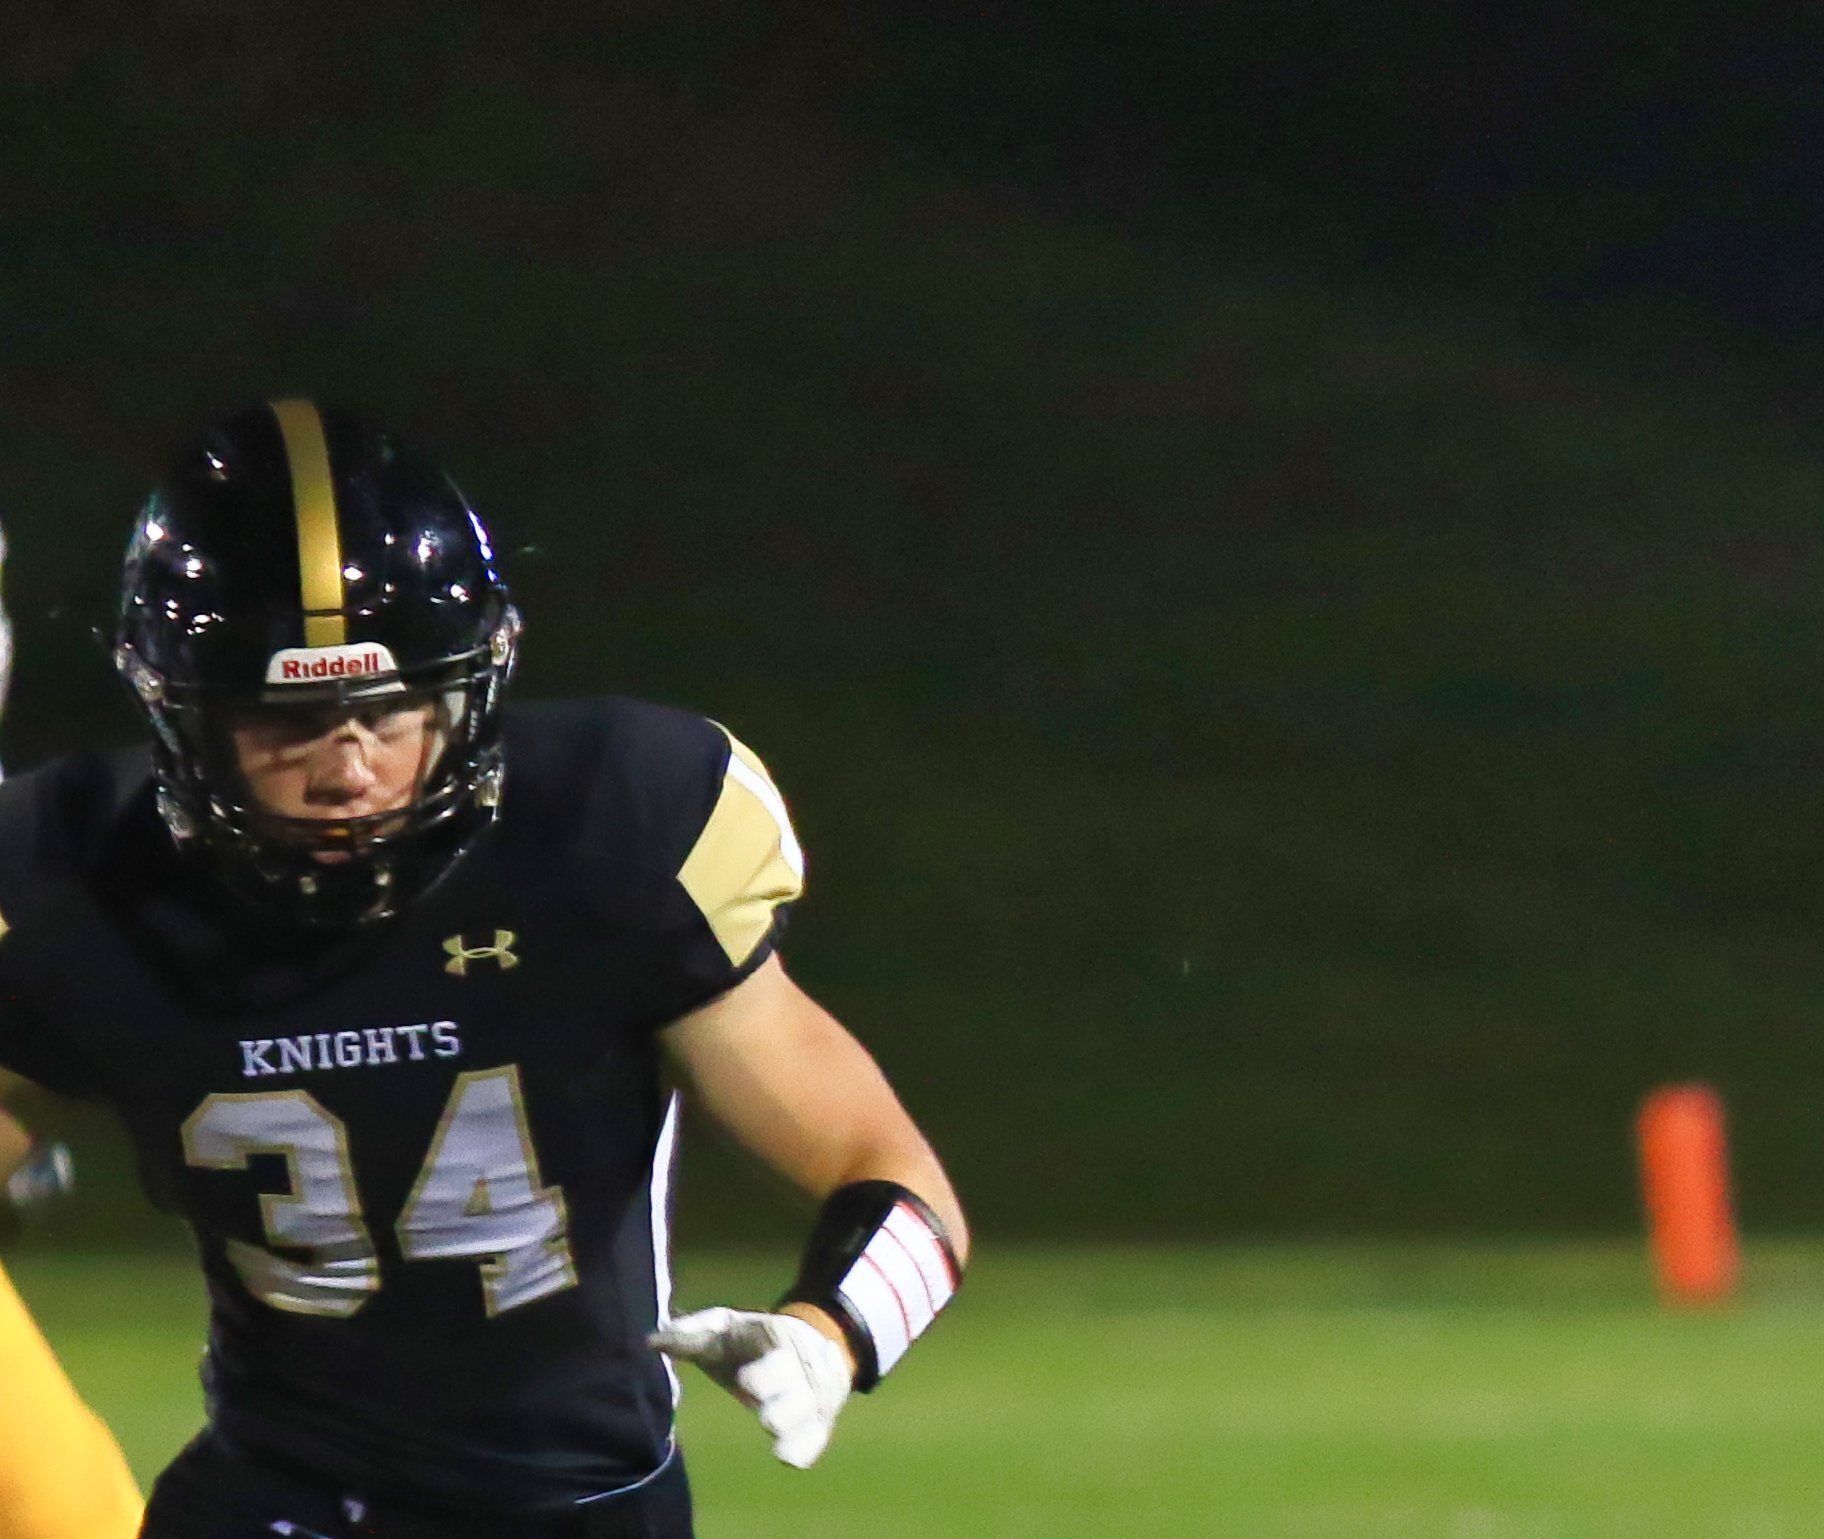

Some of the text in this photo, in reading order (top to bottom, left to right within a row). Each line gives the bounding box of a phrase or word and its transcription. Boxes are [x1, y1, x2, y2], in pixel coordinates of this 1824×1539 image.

[282, 652, 379, 679] Riddell
[238, 1020, 463, 1077] KNIGHTS
[180, 1063, 580, 1318] 34
